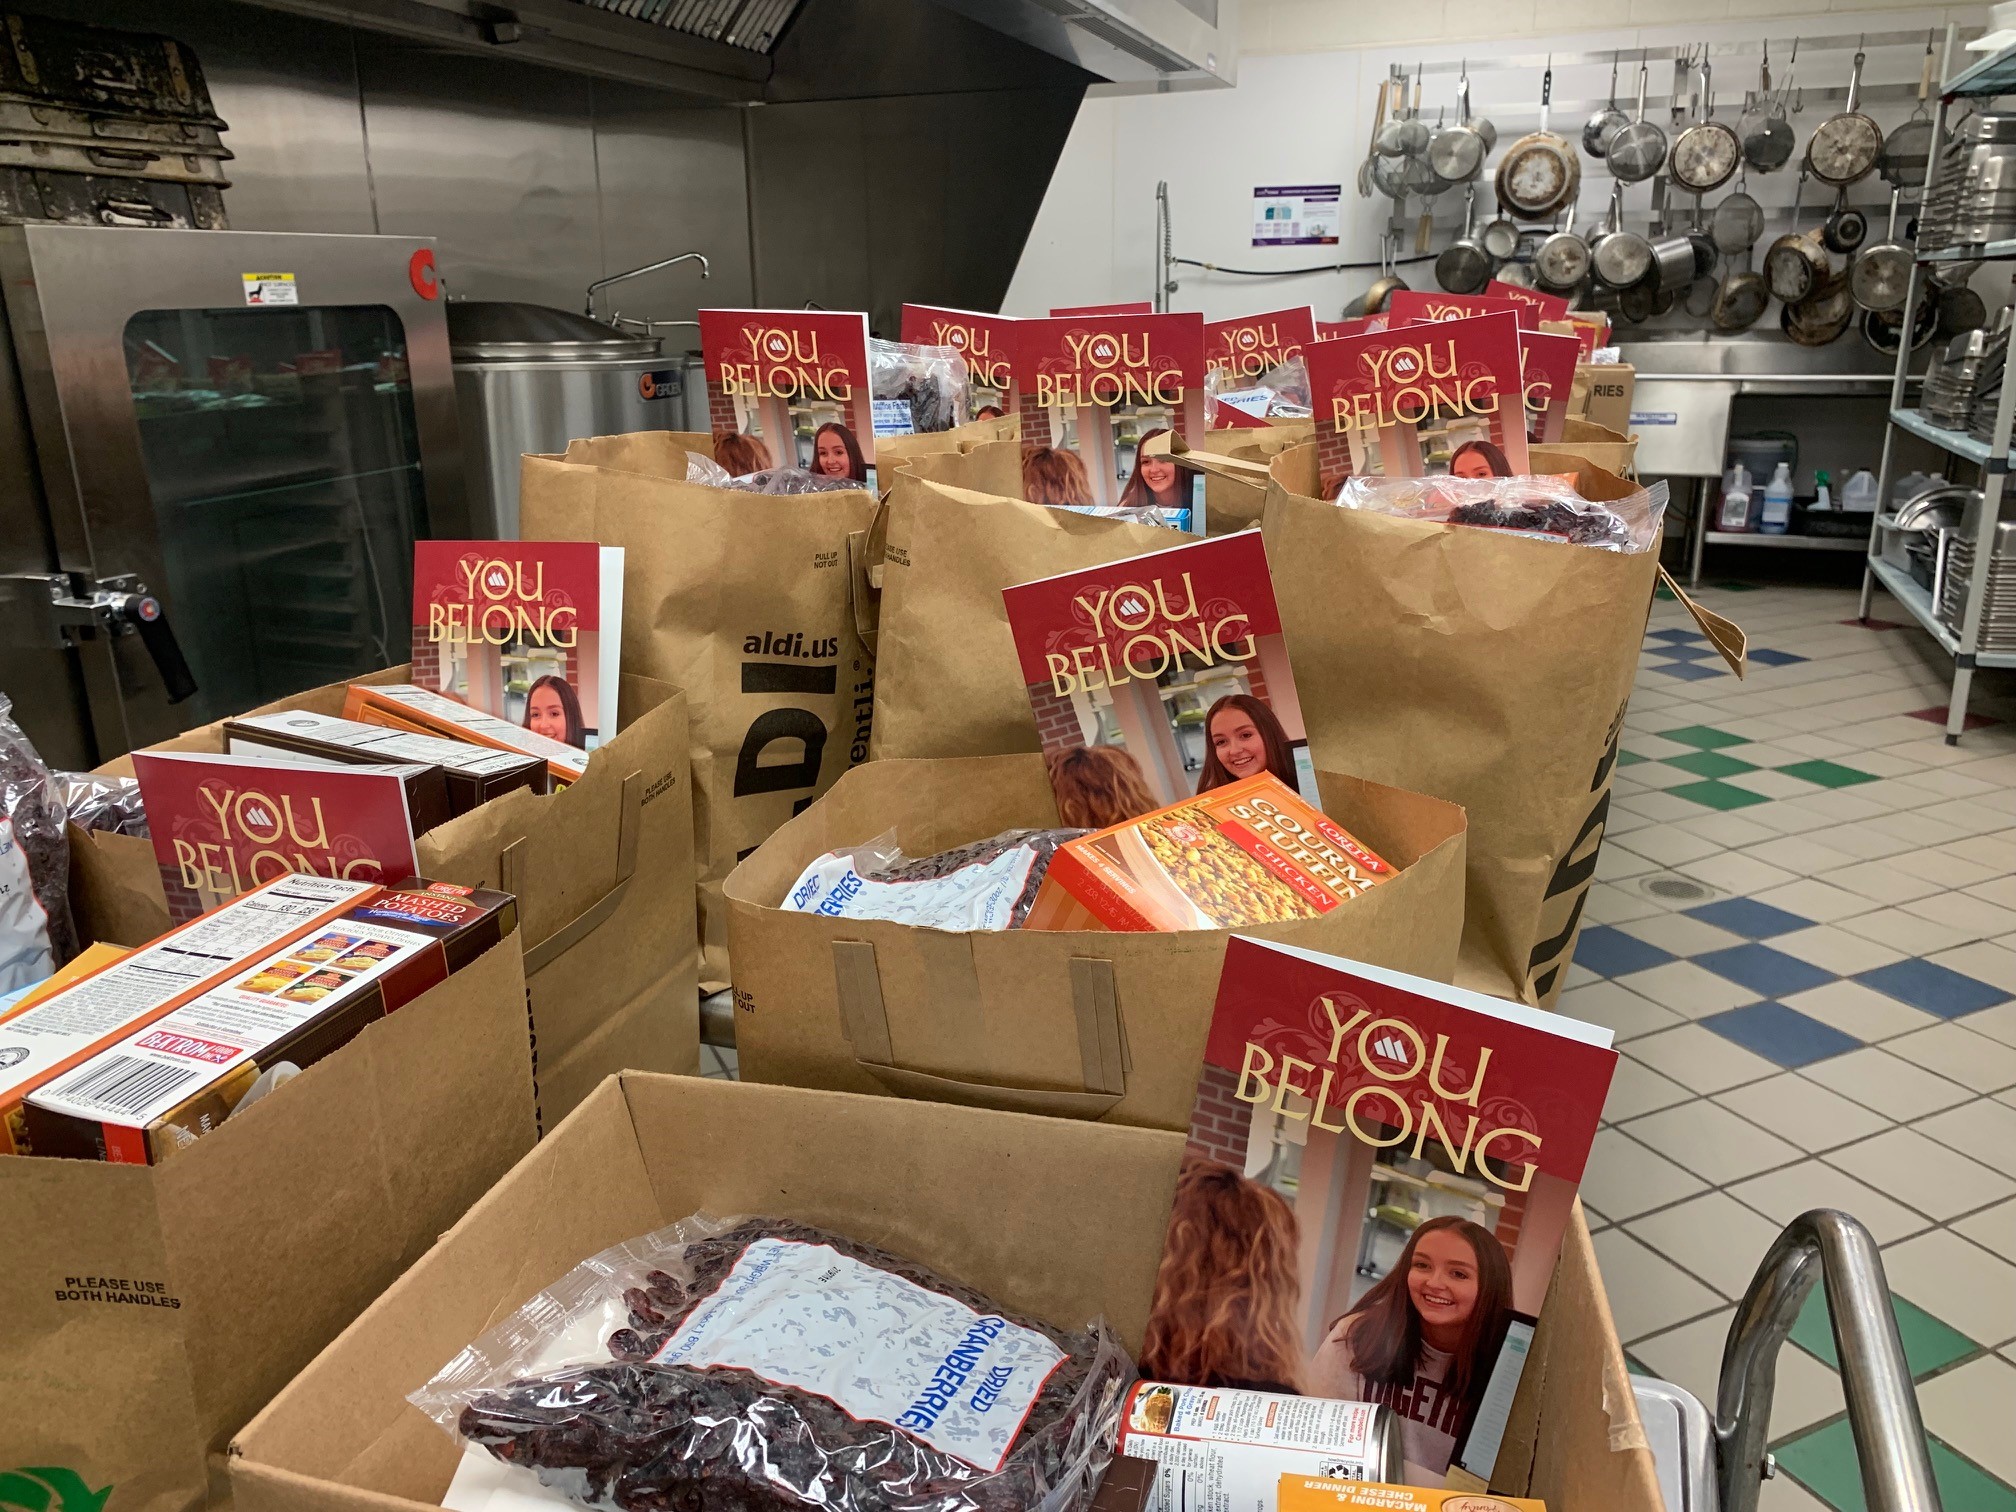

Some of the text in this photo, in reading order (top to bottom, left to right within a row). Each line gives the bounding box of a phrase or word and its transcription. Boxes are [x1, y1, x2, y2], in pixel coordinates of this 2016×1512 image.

[742, 328, 819, 364] YOU
[932, 321, 990, 357] YOU
[1064, 332, 1150, 369] YOU
[1221, 323, 1279, 354] YOU
[1361, 339, 1458, 388] YOU
[720, 363, 852, 401] BELONG
[1036, 370, 1184, 408] BELONG
[1331, 376, 1499, 434] BELONG
[814, 561, 827, 569] NOT
[815, 551, 838, 560] PULL UP
[460, 560, 544, 602] YOU
[1075, 572, 1200, 638] YOU
[429, 603, 579, 648] BELONG
[743, 631, 838, 658] aldi.us
[1045, 614, 1257, 698] BELONG
[199, 786, 330, 850] YOU
[1227, 805, 1356, 899] STUFFIN
[1250, 798, 1375, 891] GOURM
[1317, 821, 1380, 871] LORETTA
[289, 878, 357, 893] Nutrition Facts
[1075, 845, 1100, 863] MAKES
[1103, 867, 1136, 893] SERVINGS
[1255, 843, 1332, 905] CHICKEN
[389, 893, 467, 914] MASHED
[421, 891, 457, 901] INSTANT
[431, 883, 468, 896] LORETTA
[373, 899, 462, 922] POTATOES
[738, 999, 755, 1013] OUT
[741, 990, 753, 1001] UP
[142, 1031, 215, 1059] BEKTROM
[1320, 997, 1493, 1108] YOU
[136, 1113, 147, 1121] 5
[1233, 1041, 1544, 1193] BELONG
[55, 1290, 181, 1309] BOTH HANDLES
[64, 1277, 166, 1294] PLEASE USE
[895, 1317, 1006, 1434] CRANBERRIES
[970, 1366, 1013, 1413] DRIED
[1174, 1411, 1183, 1432] Baked
[1179, 1397, 1187, 1410] Pork
[1187, 1395, 1197, 1409] Gravy
[1164, 1468, 1171, 1478] 0%
[1187, 1472, 1194, 1482] 0%
[1197, 1473, 1203, 1483] 0%
[1164, 1481, 1172, 1499] Sugars
[1304, 1480, 1413, 1501] CHEESE DINNER
[1336, 1494, 1427, 1512] MACARONI &
